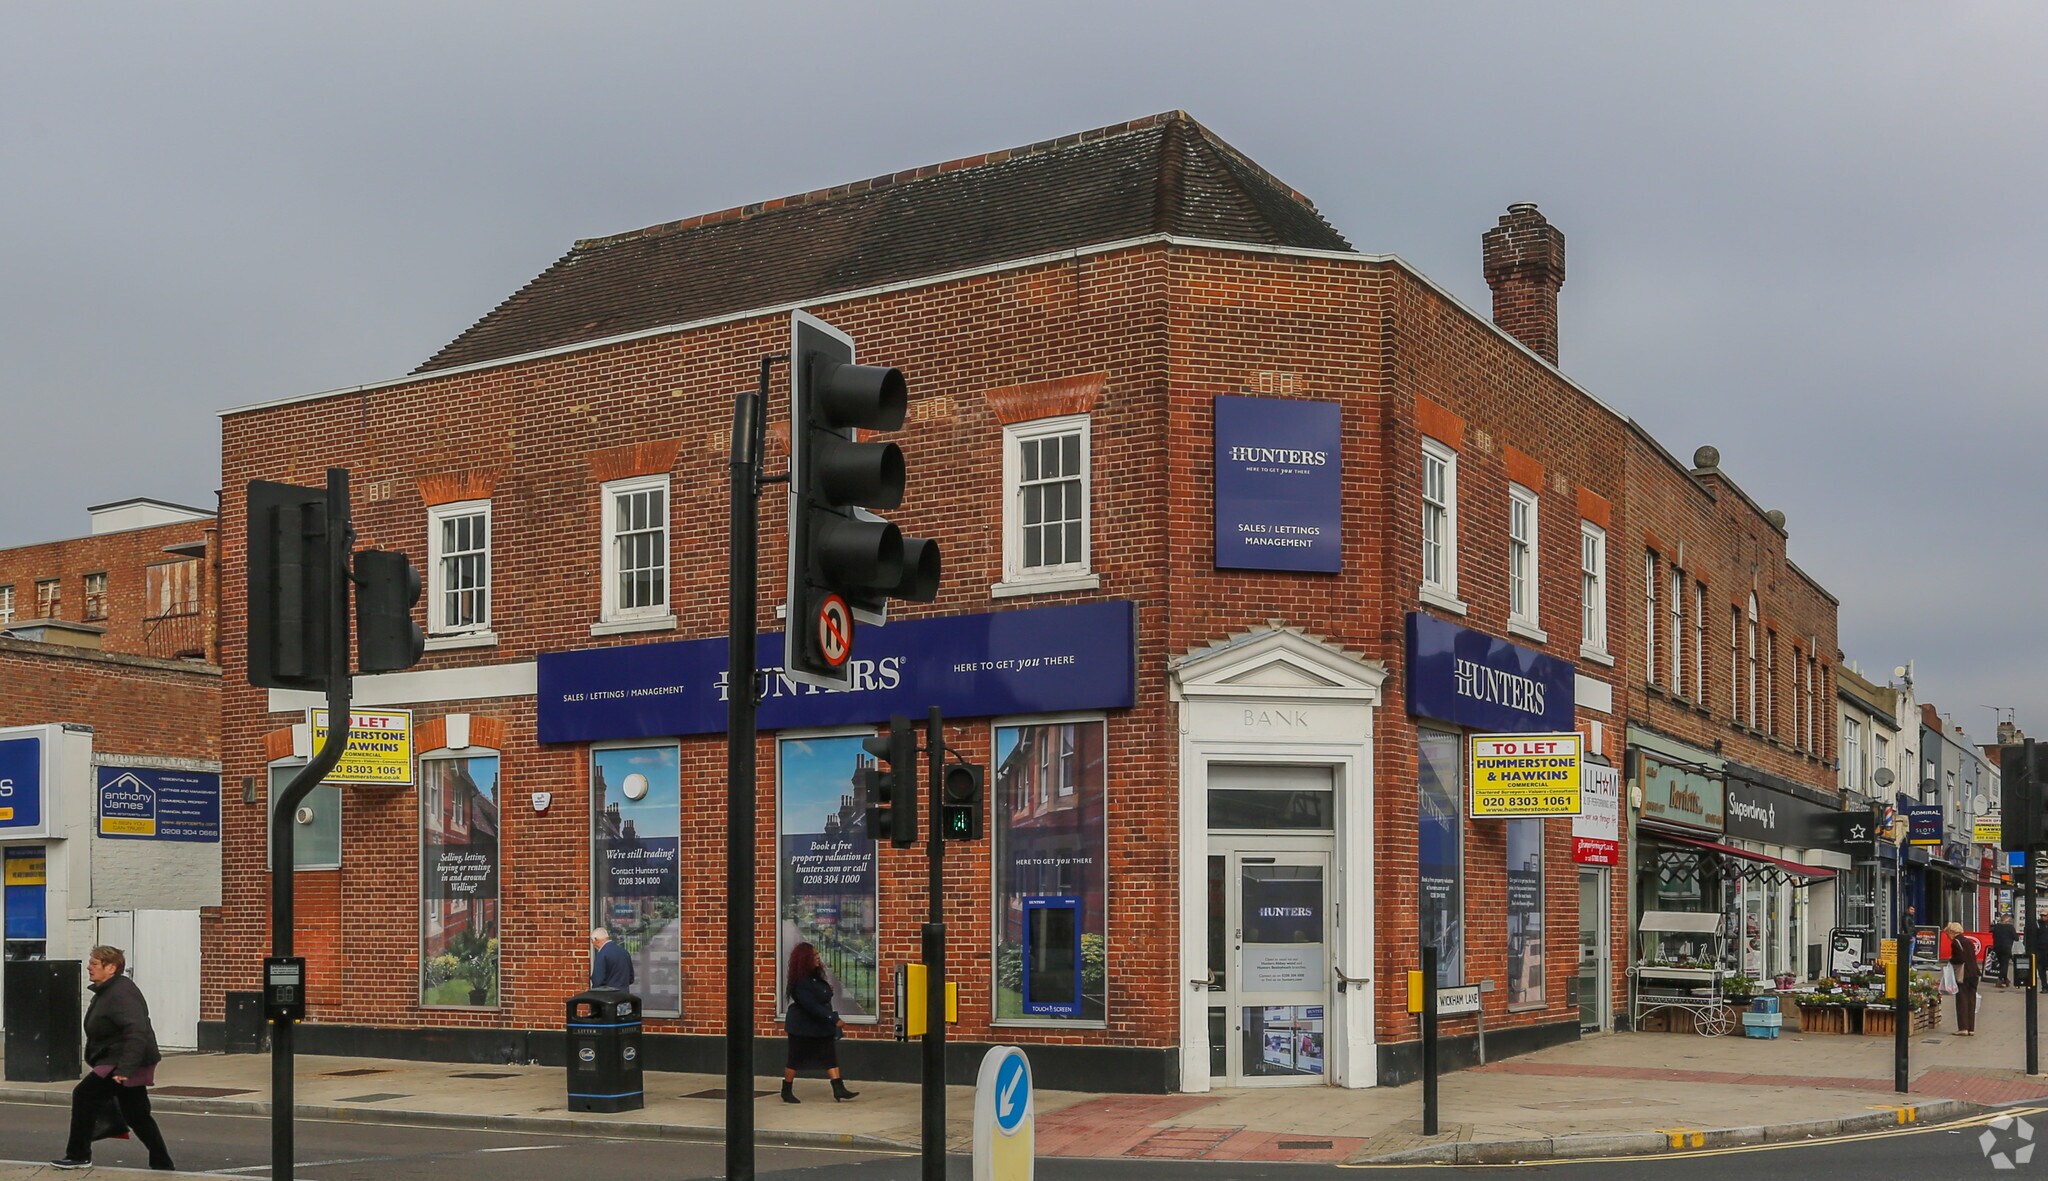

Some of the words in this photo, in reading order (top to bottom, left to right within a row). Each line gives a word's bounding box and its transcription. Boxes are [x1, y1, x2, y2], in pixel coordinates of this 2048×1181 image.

[1229, 446, 1326, 466] HUNTERS
[1238, 523, 1266, 533] SALES
[1274, 525, 1320, 535] LETTINGS
[1245, 537, 1313, 548] MANAGEMENT
[953, 662, 978, 673] HERE
[980, 661, 994, 670] TO
[996, 659, 1015, 669] GET
[1016, 657, 1040, 672] you
[1044, 655, 1075, 666] THERE
[1455, 659, 1545, 715] HUNTERS
[563, 693, 584, 702] SALES
[590, 690, 625, 700] LETTINGS
[631, 685, 684, 697] MANAGEMENT
[359, 716, 389, 728] LET
[1244, 709, 1308, 727] BANK
[346, 742, 399, 752] AWKINS
[1492, 743, 1517, 755] TO
[1523, 742, 1557, 754] LET
[1477, 758, 1576, 769] HUMMERSTONE
[346, 765, 373, 774] 8303
[377, 766, 402, 774] 1061
[1487, 772, 1497, 781] &
[1501, 770, 1569, 781] HAWKINS
[104, 792, 152, 803] anthony
[1483, 797, 1505, 807] 020
[1508, 797, 1539, 806] 8303
[1543, 796, 1571, 806] 1061
[104, 800, 144, 810] James
[1729, 792, 1768, 828] Superdrug
[810, 841, 830, 851] Book
[837, 840, 853, 854] free
[440, 853, 463, 864] Selling,
[464, 852, 487, 865] letting,
[606, 849, 626, 859] We're
[626, 848, 642, 859] still
[643, 847, 675, 860] trading!
[791, 854, 824, 865] property
[824, 850, 861, 862] valuation
[862, 852, 872, 861] at
[437, 862, 459, 874] buying
[467, 864, 491, 873] renting
[795, 864, 841, 873] hunters.com
[852, 862, 867, 872] call
[1055, 859, 1071, 867] you
[449, 872, 463, 881] and
[611, 867, 634, 875] Contact
[634, 877, 646, 885] 304
[803, 875, 822, 884] 0208
[823, 874, 839, 884] 304
[841, 874, 861, 884] 1000
[451, 882, 478, 893] Welling?
[1258, 907, 1312, 917] HUNTERS
[1440, 995, 1463, 1006] WICKHAM
[1465, 993, 1478, 1004] LANE
